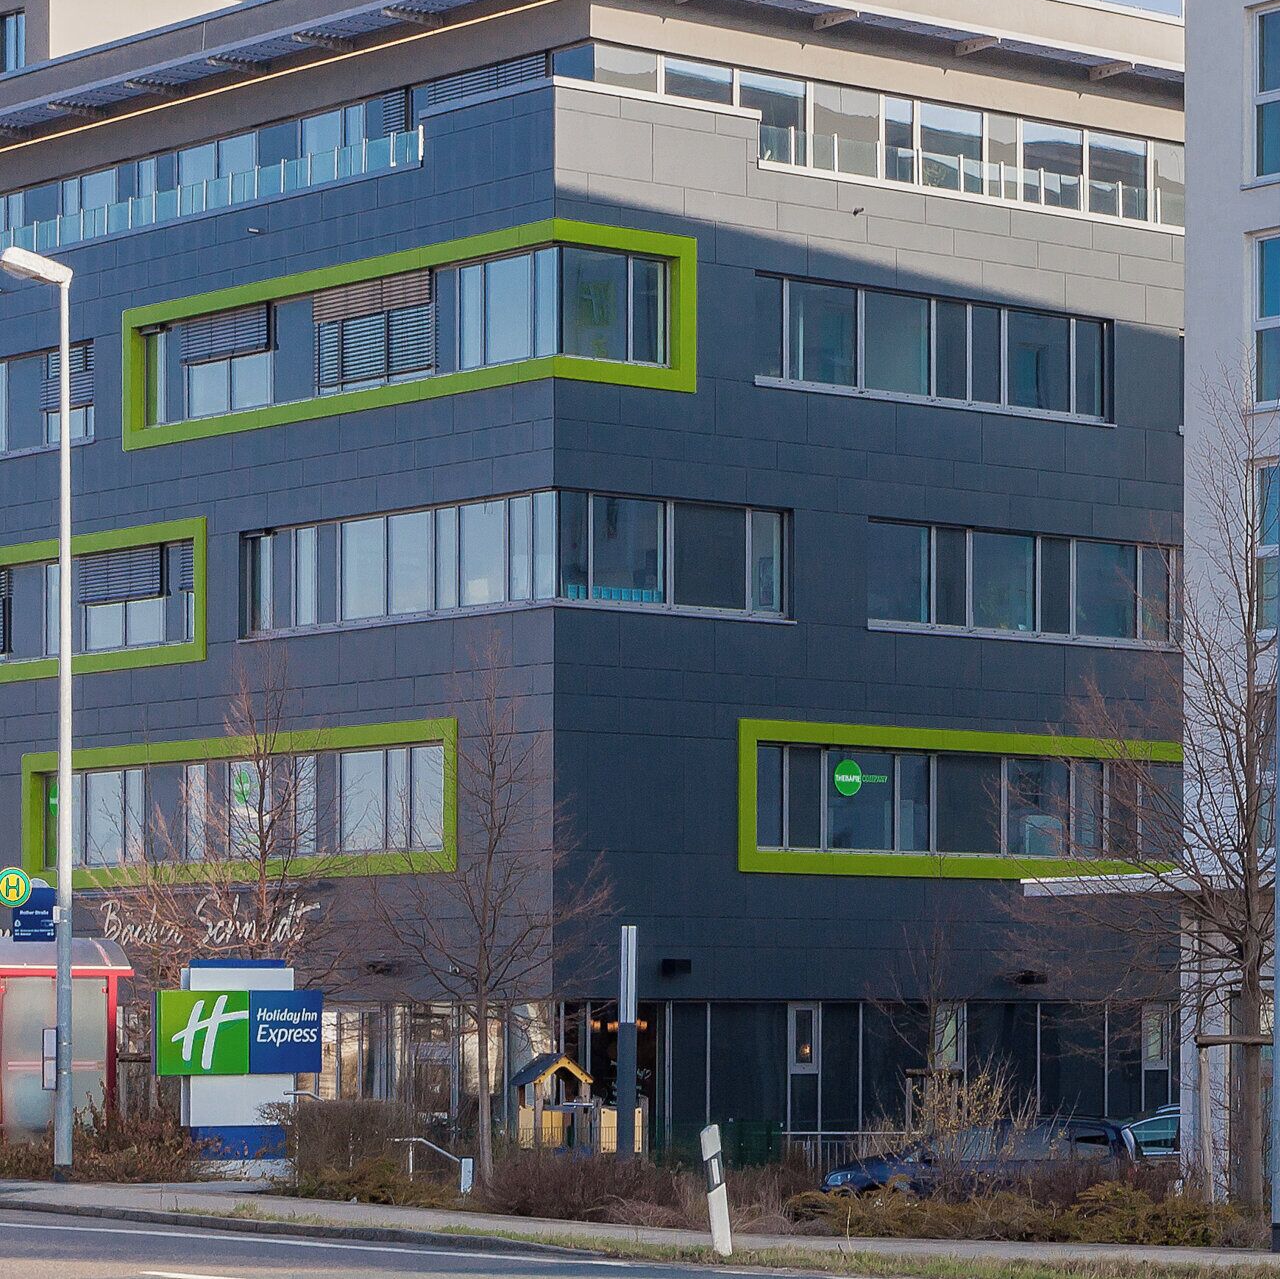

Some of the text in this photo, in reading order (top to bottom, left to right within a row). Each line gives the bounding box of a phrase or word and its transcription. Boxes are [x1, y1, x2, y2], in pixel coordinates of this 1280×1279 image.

[5, 876, 20, 898] H
[256, 1007, 318, 1024] Holiday Inn
[256, 1023, 319, 1048] Express
